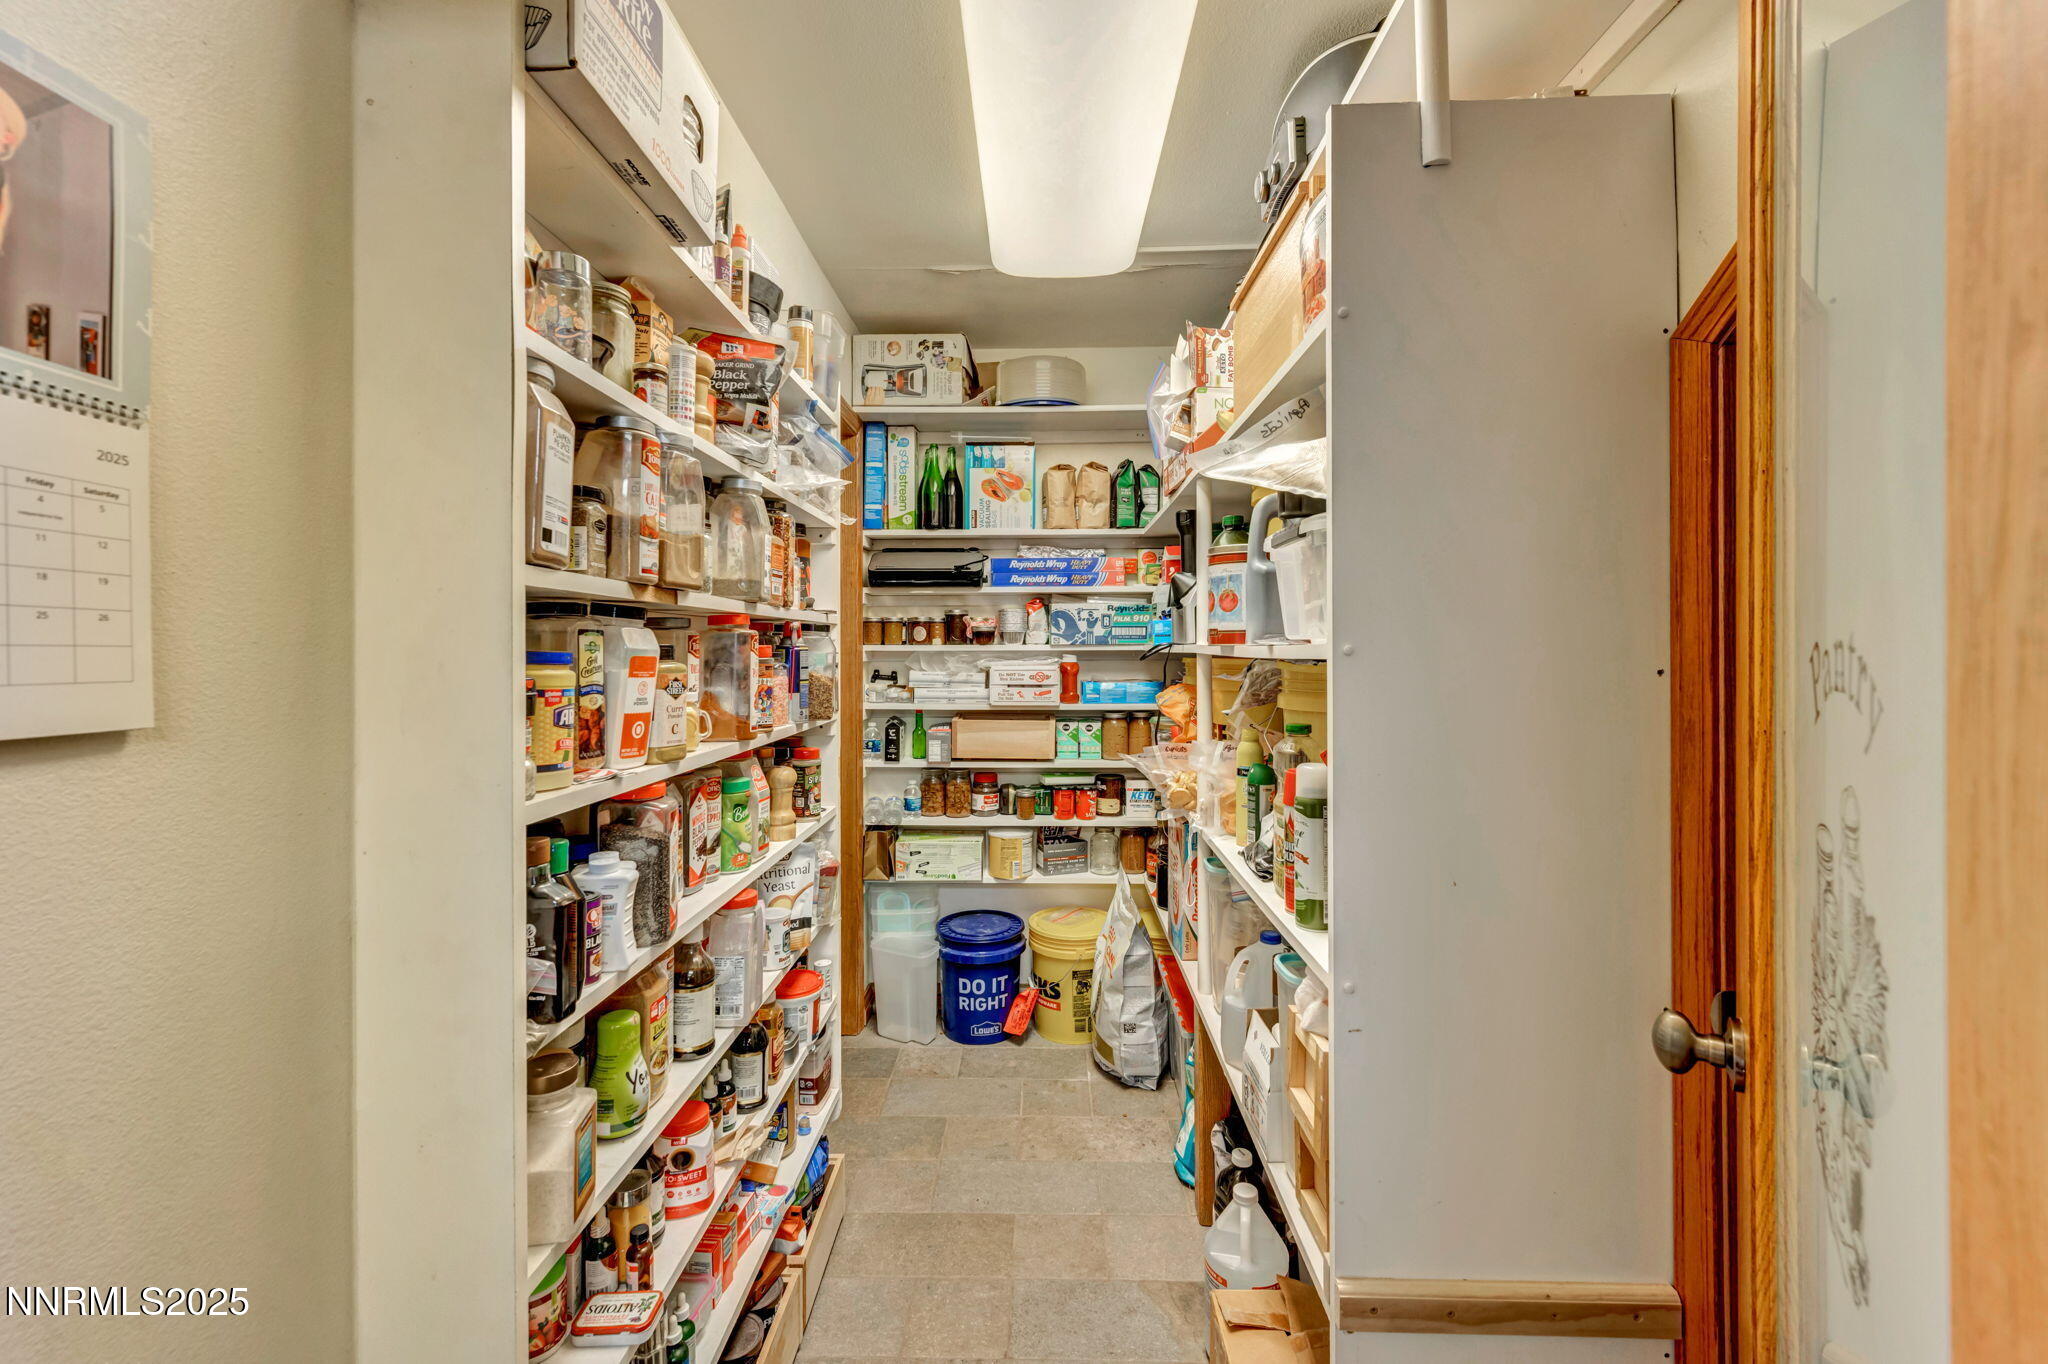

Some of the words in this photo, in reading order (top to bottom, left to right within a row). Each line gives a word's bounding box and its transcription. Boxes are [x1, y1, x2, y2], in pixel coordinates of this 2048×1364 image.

[713, 369, 748, 381] Black
[709, 379, 750, 392] Pepper
[96, 450, 130, 466] 2025
[898, 450, 909, 511] sodastream
[83, 486, 120, 500] Saturday
[35, 531, 47, 542] 11
[97, 540, 108, 550] 12
[1009, 559, 1045, 569] Reynolds
[1046, 559, 1067, 569] Wrap
[36, 571, 48, 581] 18
[98, 577, 109, 586] 19
[1010, 574, 1046, 584] Reynolds
[1046, 575, 1068, 584] Wrap
[1107, 604, 1151, 614] Reynolds
[36, 610, 49, 620] 25
[98, 613, 109, 622] 26
[1133, 614, 1150, 622] 910
[666, 704, 684, 714] Curry
[671, 723, 679, 735] C
[1131, 791, 1155, 800] KETO
[763, 880, 796, 893] Yeast
[958, 977, 986, 995] DO
[991, 974, 1009, 993] IT
[959, 993, 1009, 1011] RIGHT
[677, 1169, 702, 1182] SWEET
[586, 1303, 640, 1315] ALTOIDS
